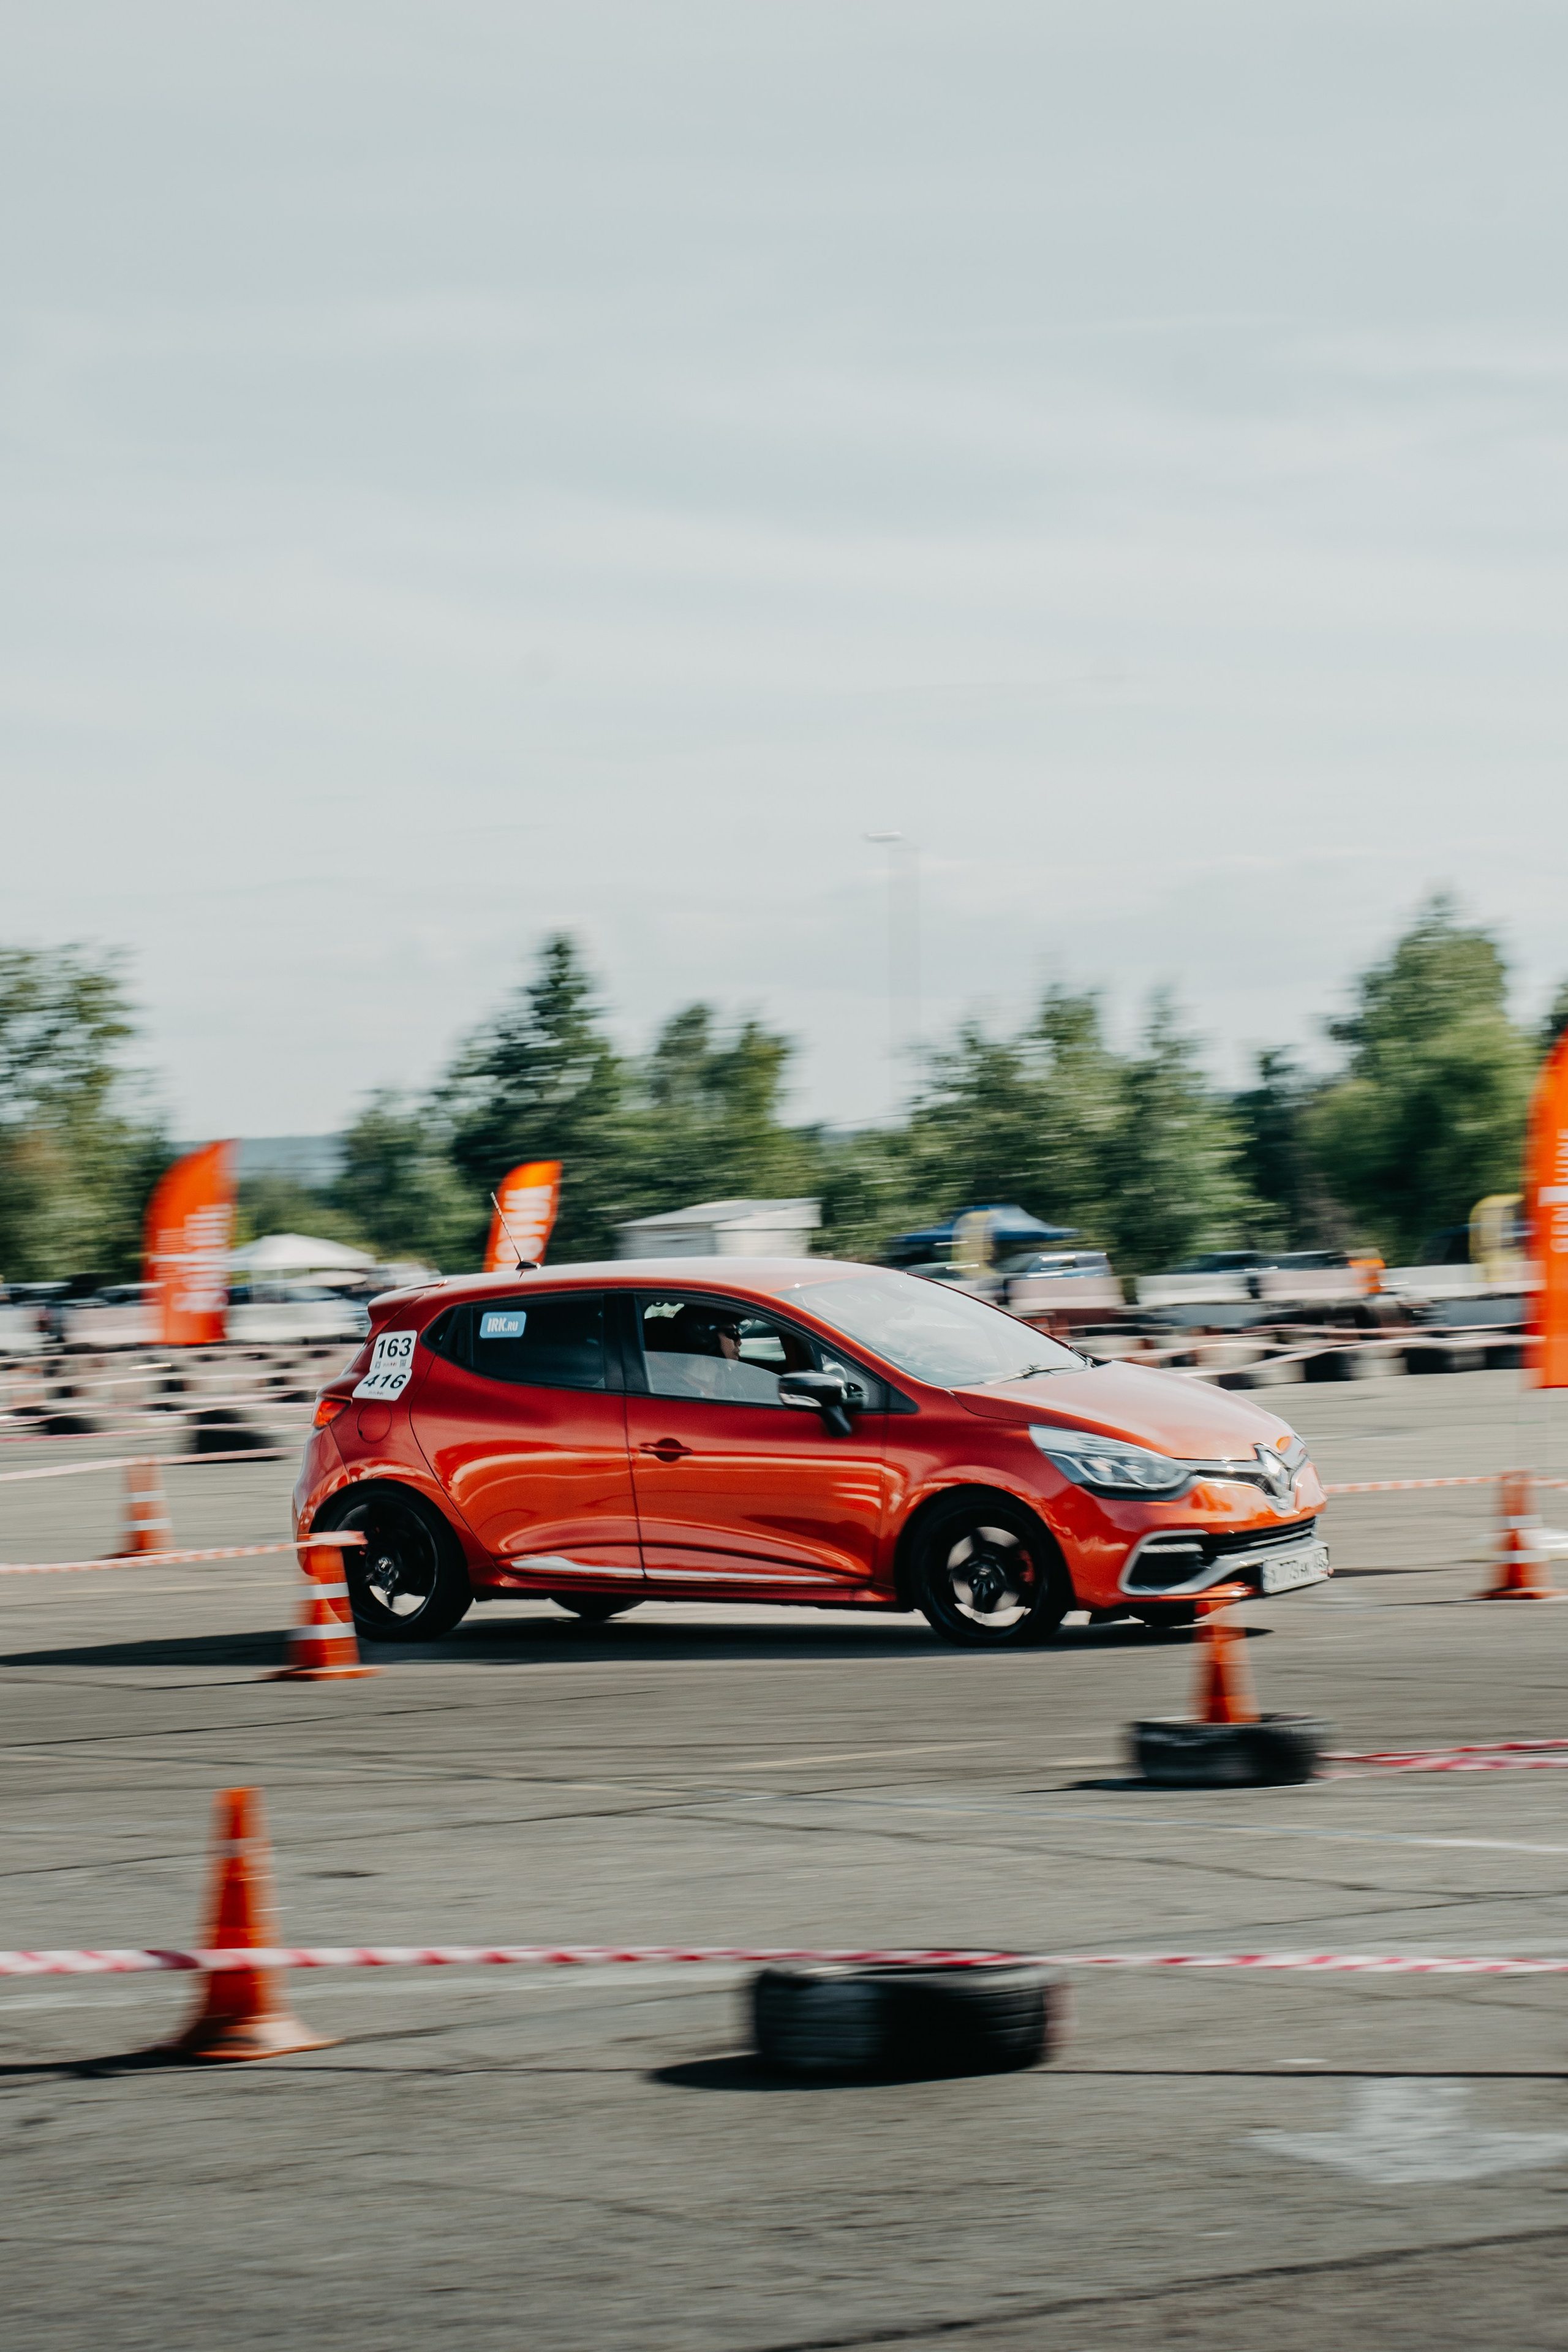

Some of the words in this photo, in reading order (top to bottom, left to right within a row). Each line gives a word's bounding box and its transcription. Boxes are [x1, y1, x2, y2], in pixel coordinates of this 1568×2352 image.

[487, 1317, 519, 1332] IRK.RU
[378, 1337, 412, 1359] 163
[363, 1374, 407, 1389] 416
